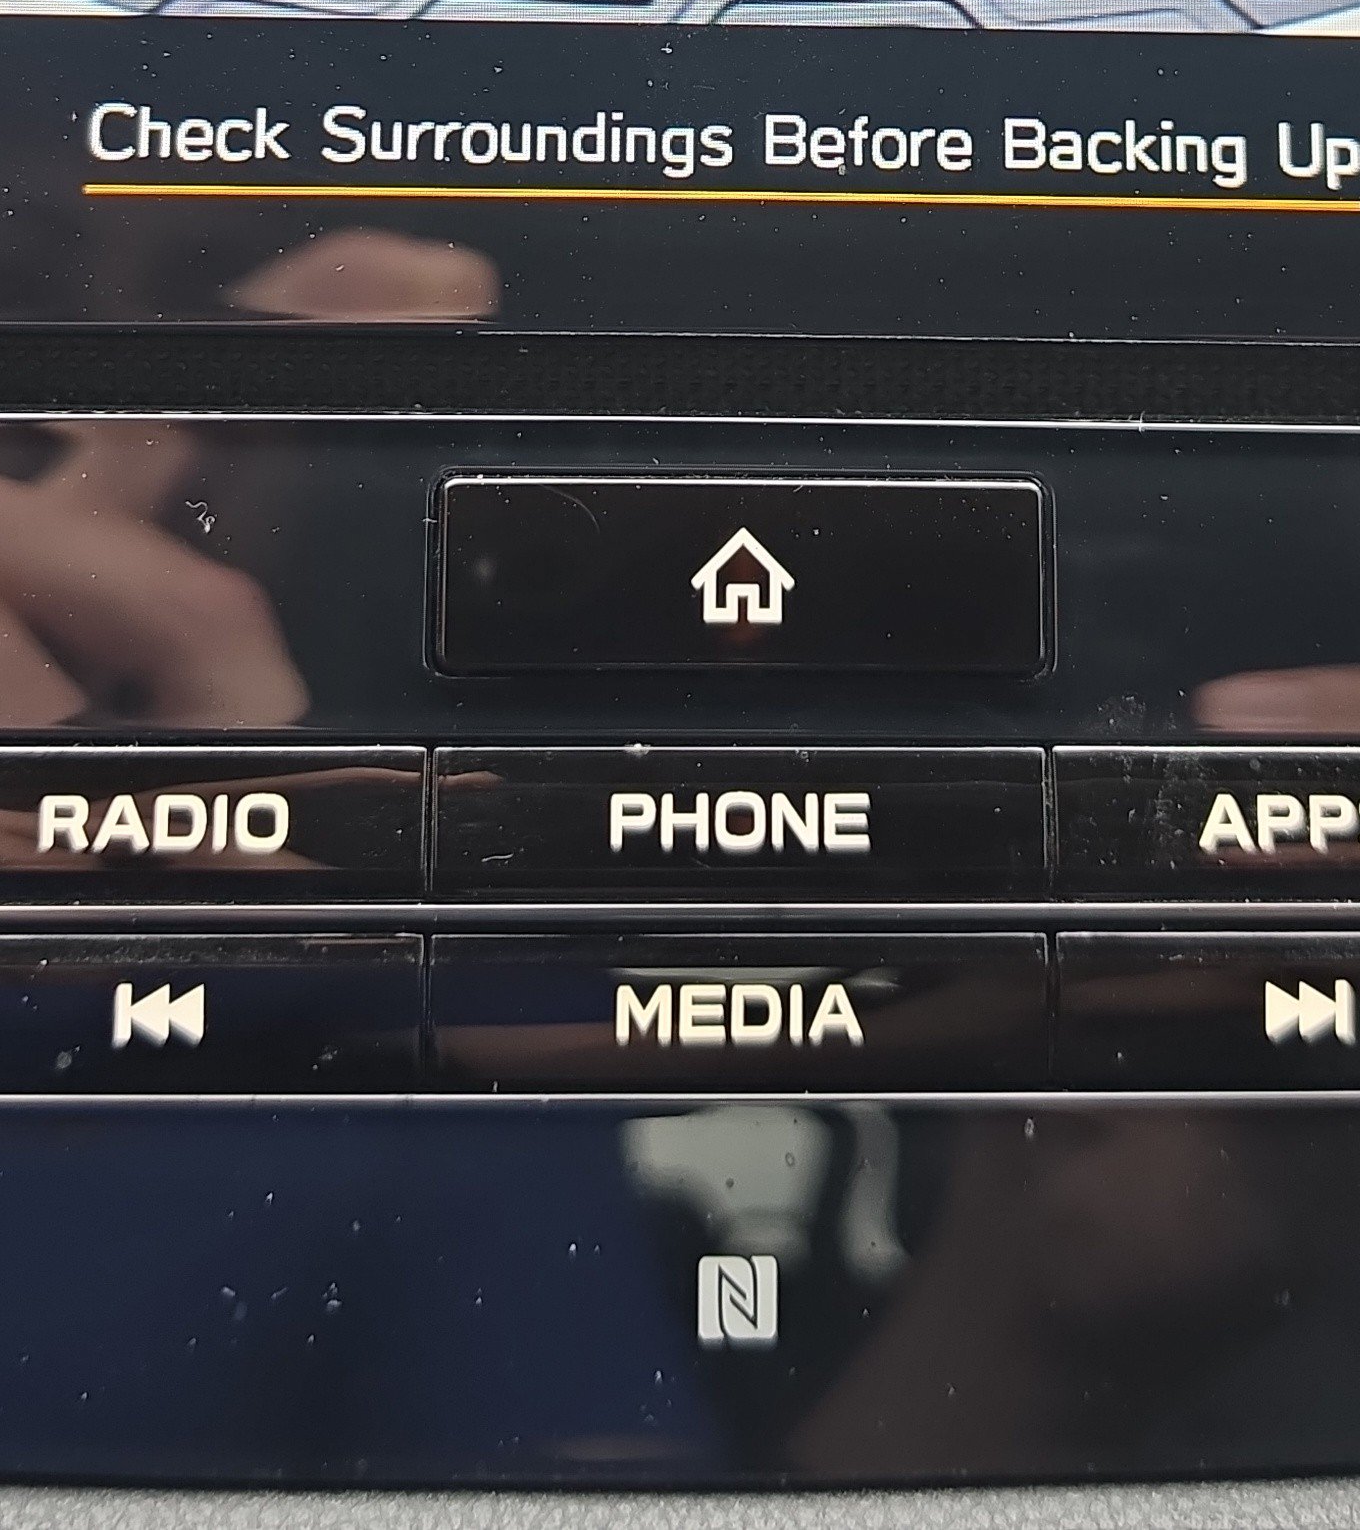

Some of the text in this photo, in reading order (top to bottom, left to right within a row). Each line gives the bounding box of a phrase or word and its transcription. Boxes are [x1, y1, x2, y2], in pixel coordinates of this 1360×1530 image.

[89, 102, 291, 162] Check
[321, 104, 734, 178] Surroundings
[764, 113, 973, 171] Before
[1003, 116, 1248, 189] Backing
[38, 792, 290, 854] RADIO
[609, 790, 872, 853] PHONE
[615, 983, 864, 1047] MEDIA
